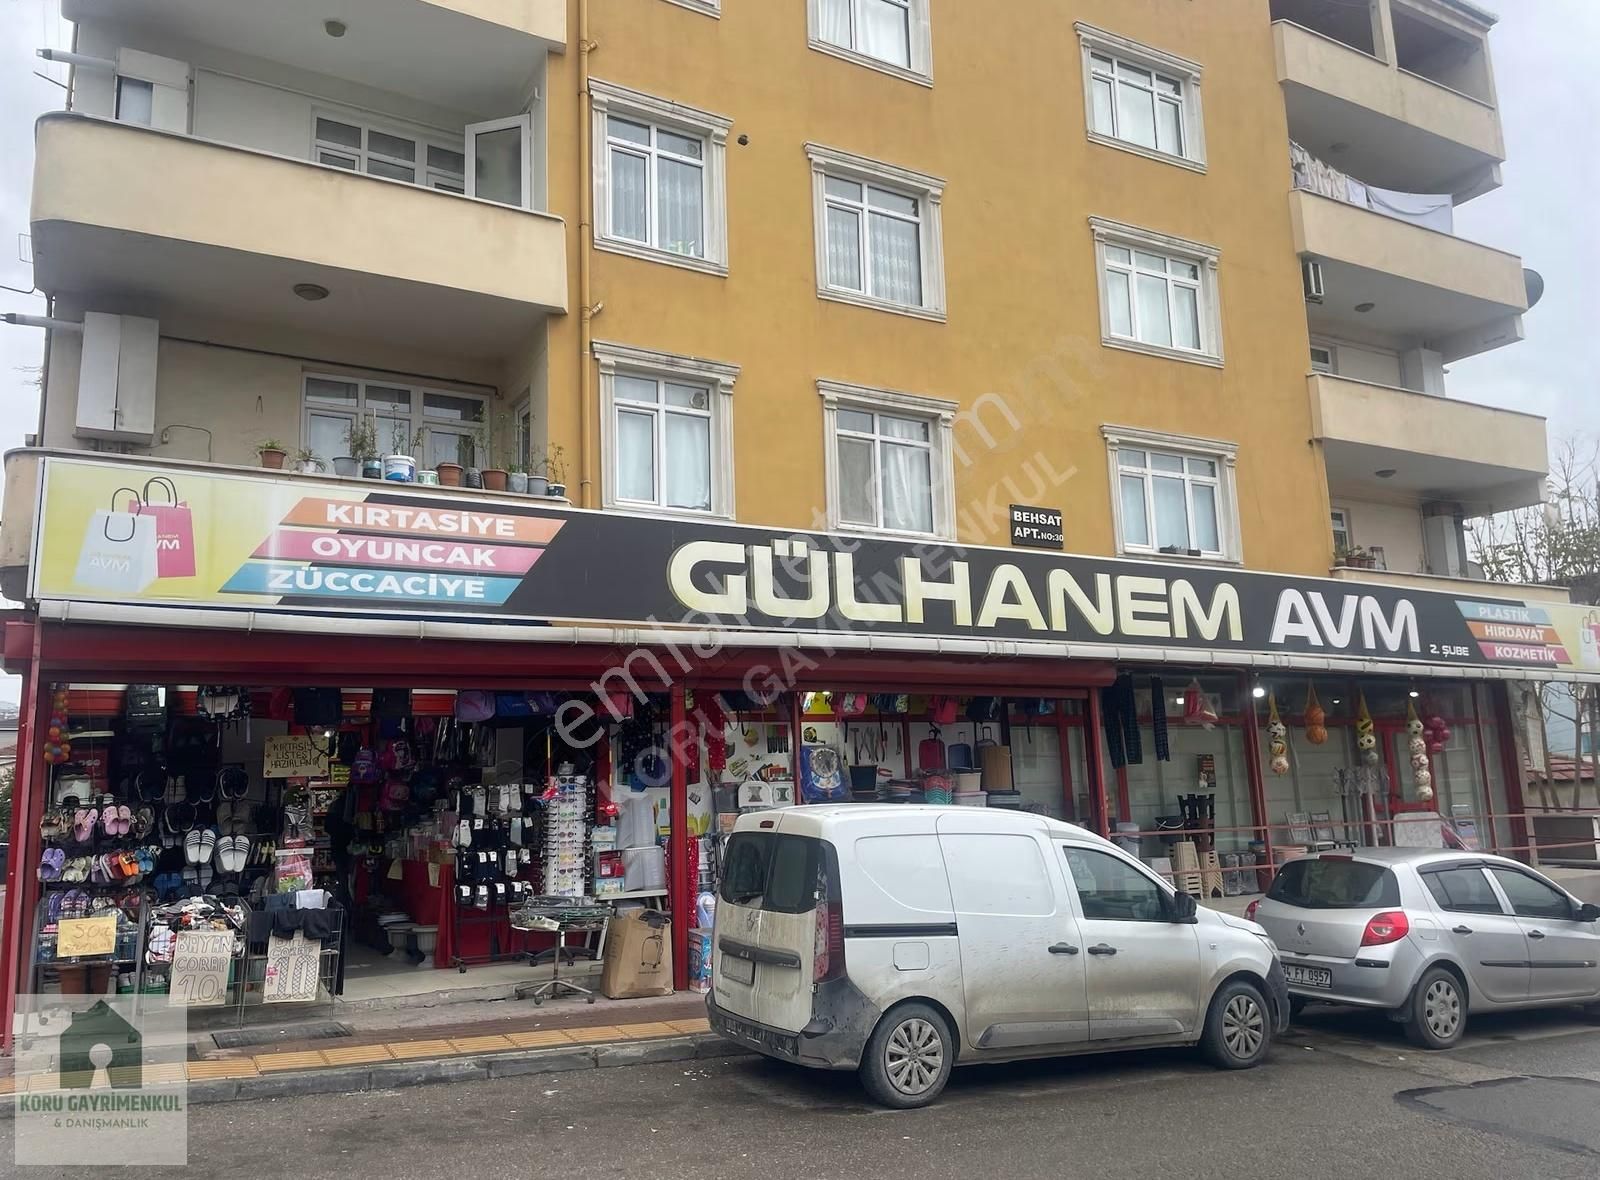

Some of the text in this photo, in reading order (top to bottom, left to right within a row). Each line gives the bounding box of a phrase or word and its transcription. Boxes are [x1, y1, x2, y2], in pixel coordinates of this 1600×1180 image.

[326, 502, 516, 537] KIRTASİYE
[1013, 510, 1062, 527] BEHSAT
[311, 536, 496, 567] OYUNCAK
[89, 557, 130, 574] AVM
[267, 564, 485, 599] ZÜCCACİYE
[667, 538, 1421, 654] GÜLHANEM AVM
[1479, 606, 1530, 622] PLASTİK
[1484, 625, 1544, 641] HIRDAVAT
[1429, 644, 1470, 658] 2. ŞUBE
[1494, 644, 1557, 662] KOZMETİK
[178, 934, 232, 953] BAYAN
